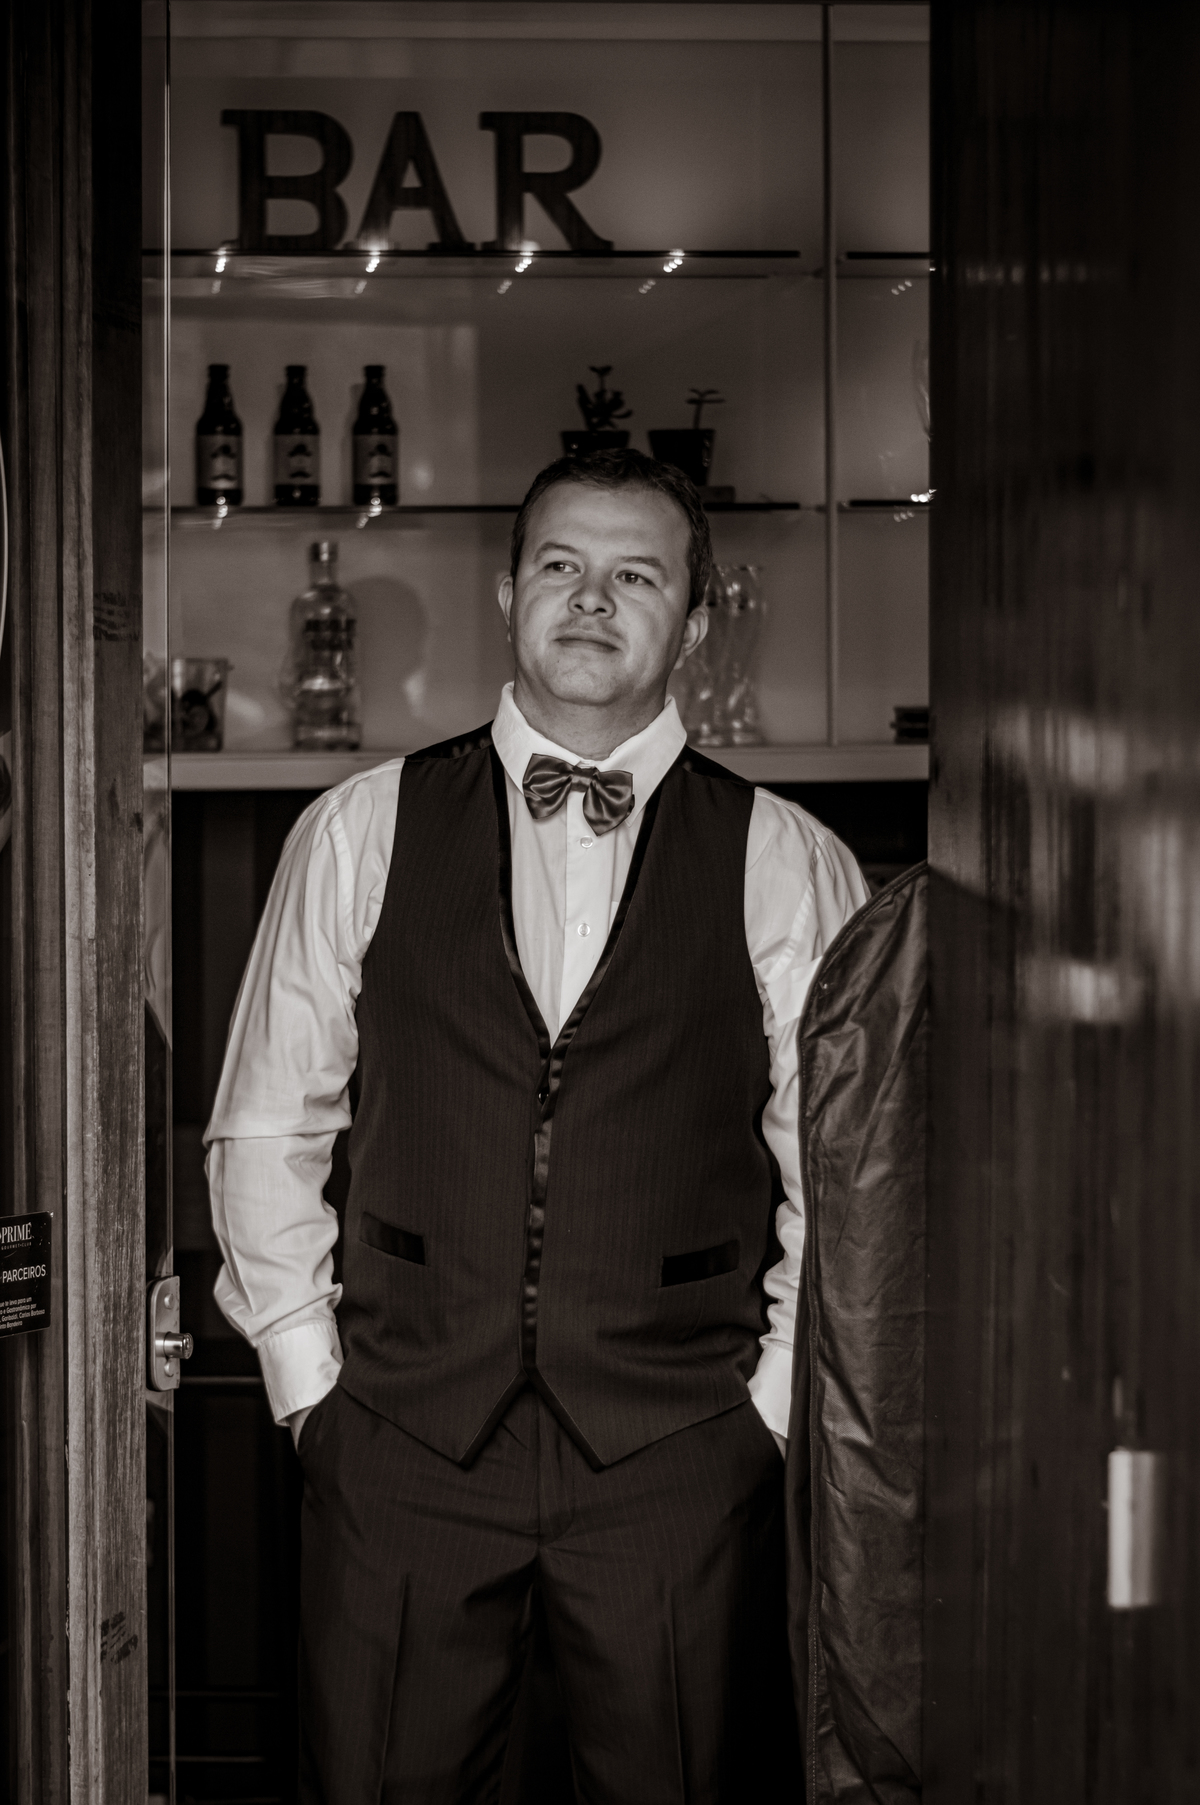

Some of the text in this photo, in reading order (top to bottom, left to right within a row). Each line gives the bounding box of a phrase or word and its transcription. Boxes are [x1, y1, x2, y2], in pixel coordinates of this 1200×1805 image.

[220, 109, 614, 250] BAR
[0, 1222, 32, 1244] PRIME
[2, 1264, 46, 1283] PARCEIROS
